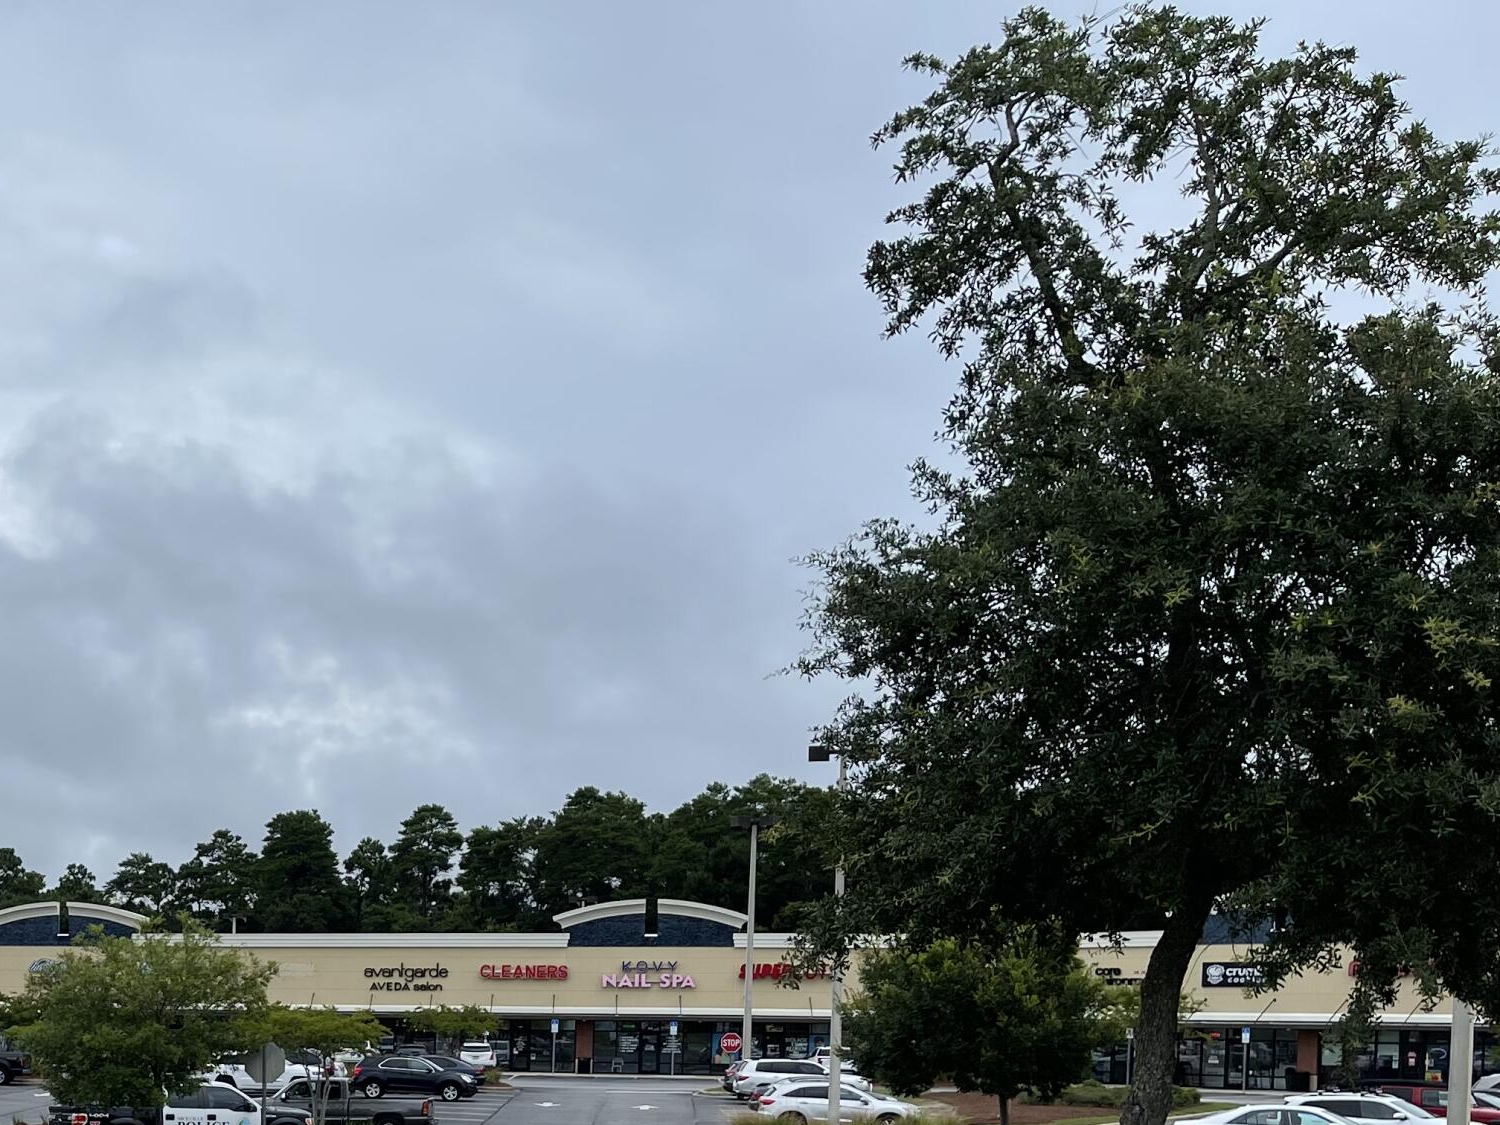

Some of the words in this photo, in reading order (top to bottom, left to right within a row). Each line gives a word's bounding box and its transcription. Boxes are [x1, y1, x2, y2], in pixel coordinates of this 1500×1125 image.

[364, 962, 449, 982] avantgarde
[479, 964, 569, 980] CLEANERS
[369, 982, 410, 991] AVEDA
[413, 981, 443, 991] salon
[602, 973, 651, 988] NAIL
[660, 973, 696, 988] SPA
[722, 1039, 740, 1047] STOP
